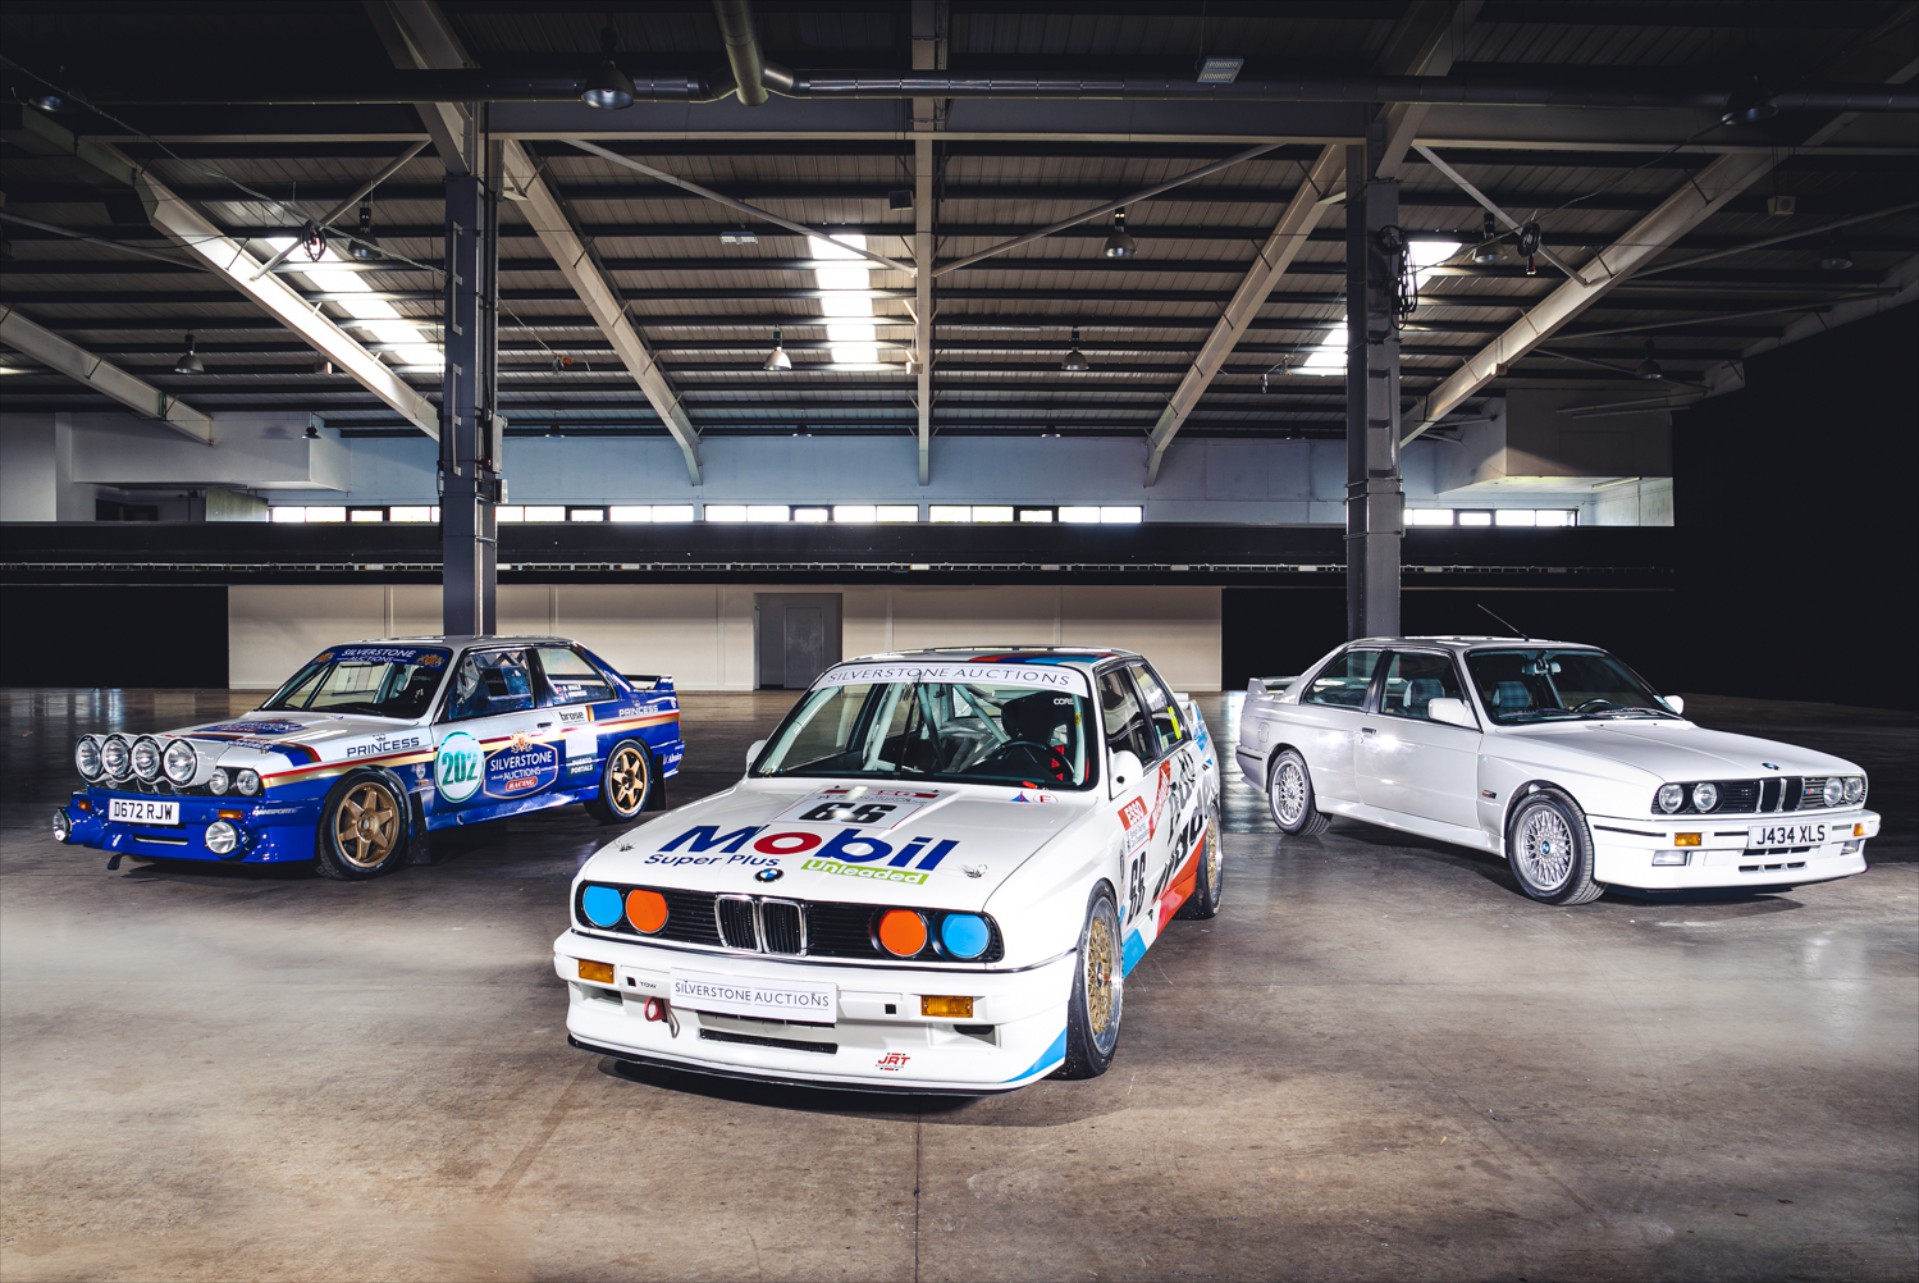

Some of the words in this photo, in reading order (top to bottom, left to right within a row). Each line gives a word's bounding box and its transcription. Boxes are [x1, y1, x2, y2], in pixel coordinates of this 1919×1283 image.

[341, 648, 417, 658] SILVERSTONE
[828, 668, 949, 682] SILVERSTONE
[953, 669, 1070, 686] AUCTIONS
[559, 711, 585, 721] brose
[619, 705, 659, 717] PRINCESS
[347, 737, 419, 758] PRINCESS
[441, 750, 478, 786] 202
[490, 751, 553, 772] SILVERSTONE
[570, 764, 594, 775] PORTALS
[503, 766, 541, 781] AUCTIONS
[508, 779, 535, 790] RACING
[113, 802, 144, 819] D672
[147, 804, 173, 820] RJW
[798, 802, 898, 824] 66
[1756, 827, 1796, 845] J434
[1799, 824, 1825, 843] XLS
[657, 824, 960, 871] Mobil
[643, 853, 721, 867] Super
[726, 854, 781, 867] Plus
[807, 860, 924, 884] Unleaded
[1127, 851, 1147, 925] 66
[640, 981, 657, 989] TOW
[675, 982, 751, 1001] SILVERSTONE
[754, 991, 830, 1007] AUCTIONS
[878, 1056, 911, 1066] JRT
